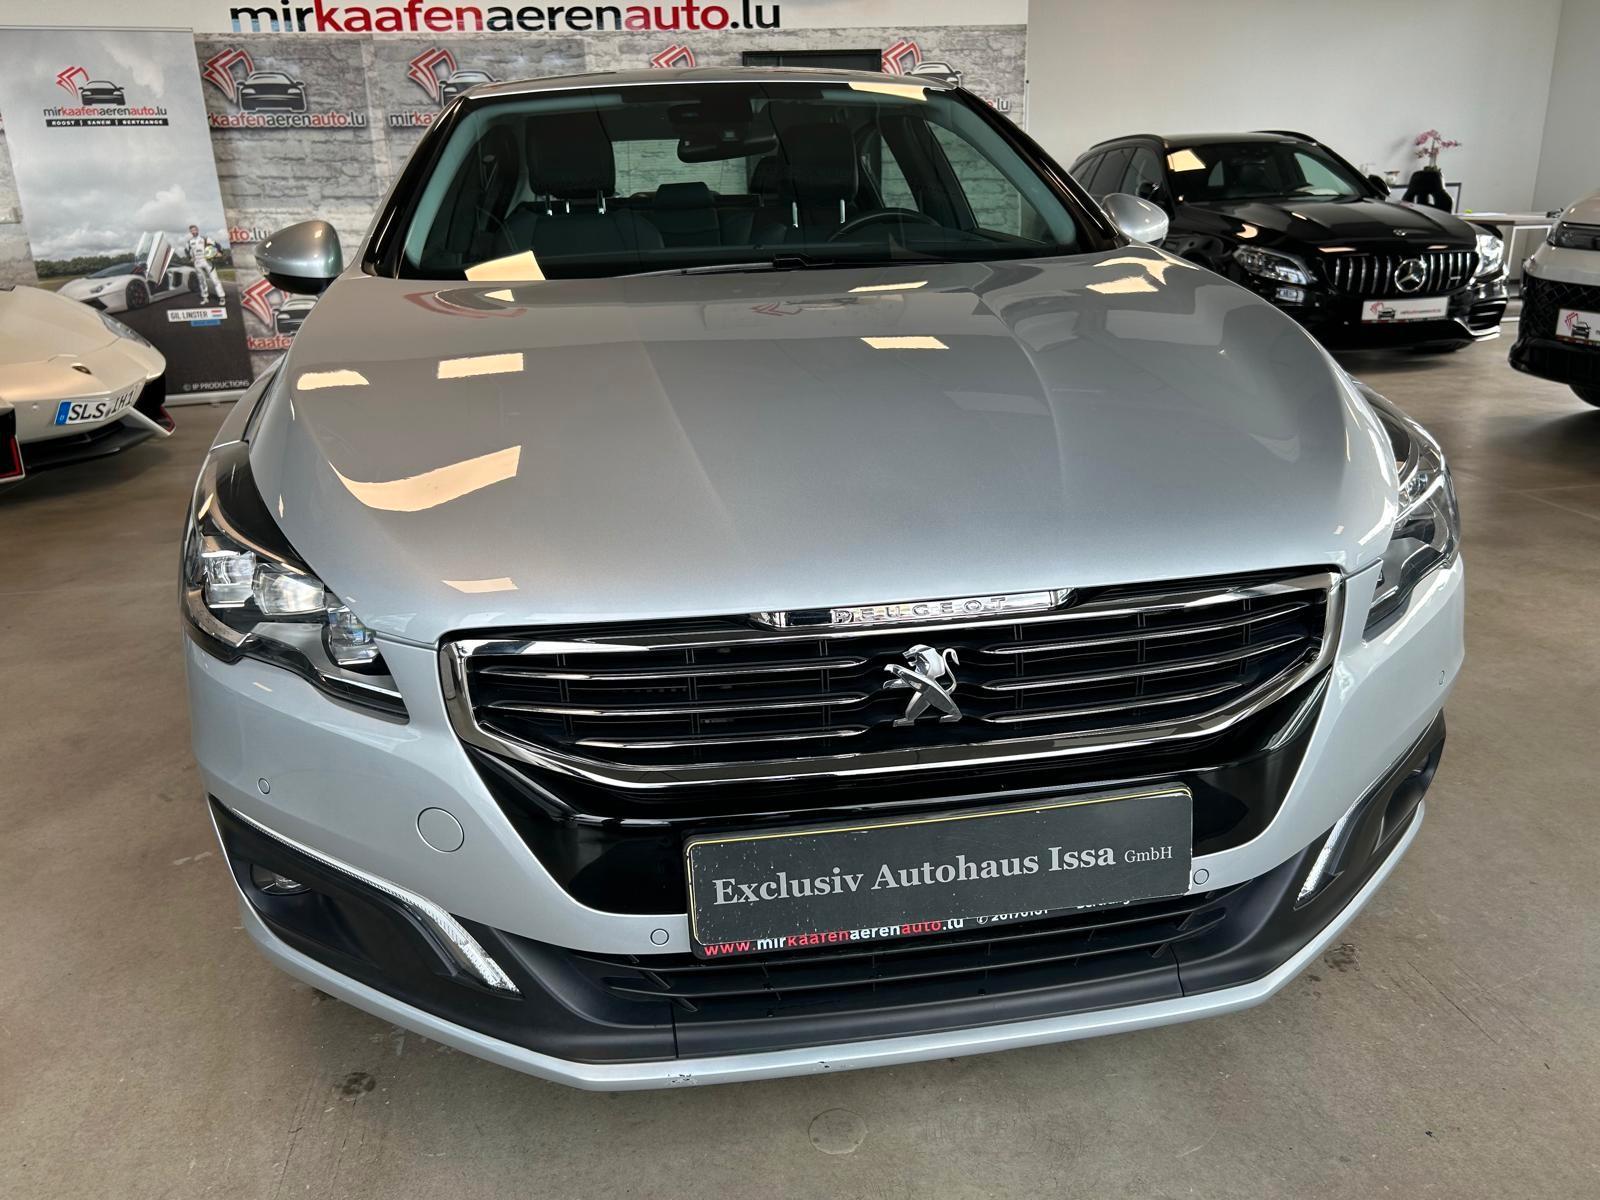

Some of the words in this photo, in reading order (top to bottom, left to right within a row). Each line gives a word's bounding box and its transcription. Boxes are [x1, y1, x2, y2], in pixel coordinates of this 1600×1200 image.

[230, 0, 780, 33] mirkaafenaerenauto.lu
[43, 106, 168, 117] mirkaafenaerenauto.lu
[68, 402, 107, 421] SLS
[831, 596, 1006, 624] PEUGEOT
[712, 866, 864, 906] Exclusiv
[871, 854, 1039, 891] Autohaus
[1048, 845, 1116, 872] Issa
[1124, 846, 1173, 864] GmbH
